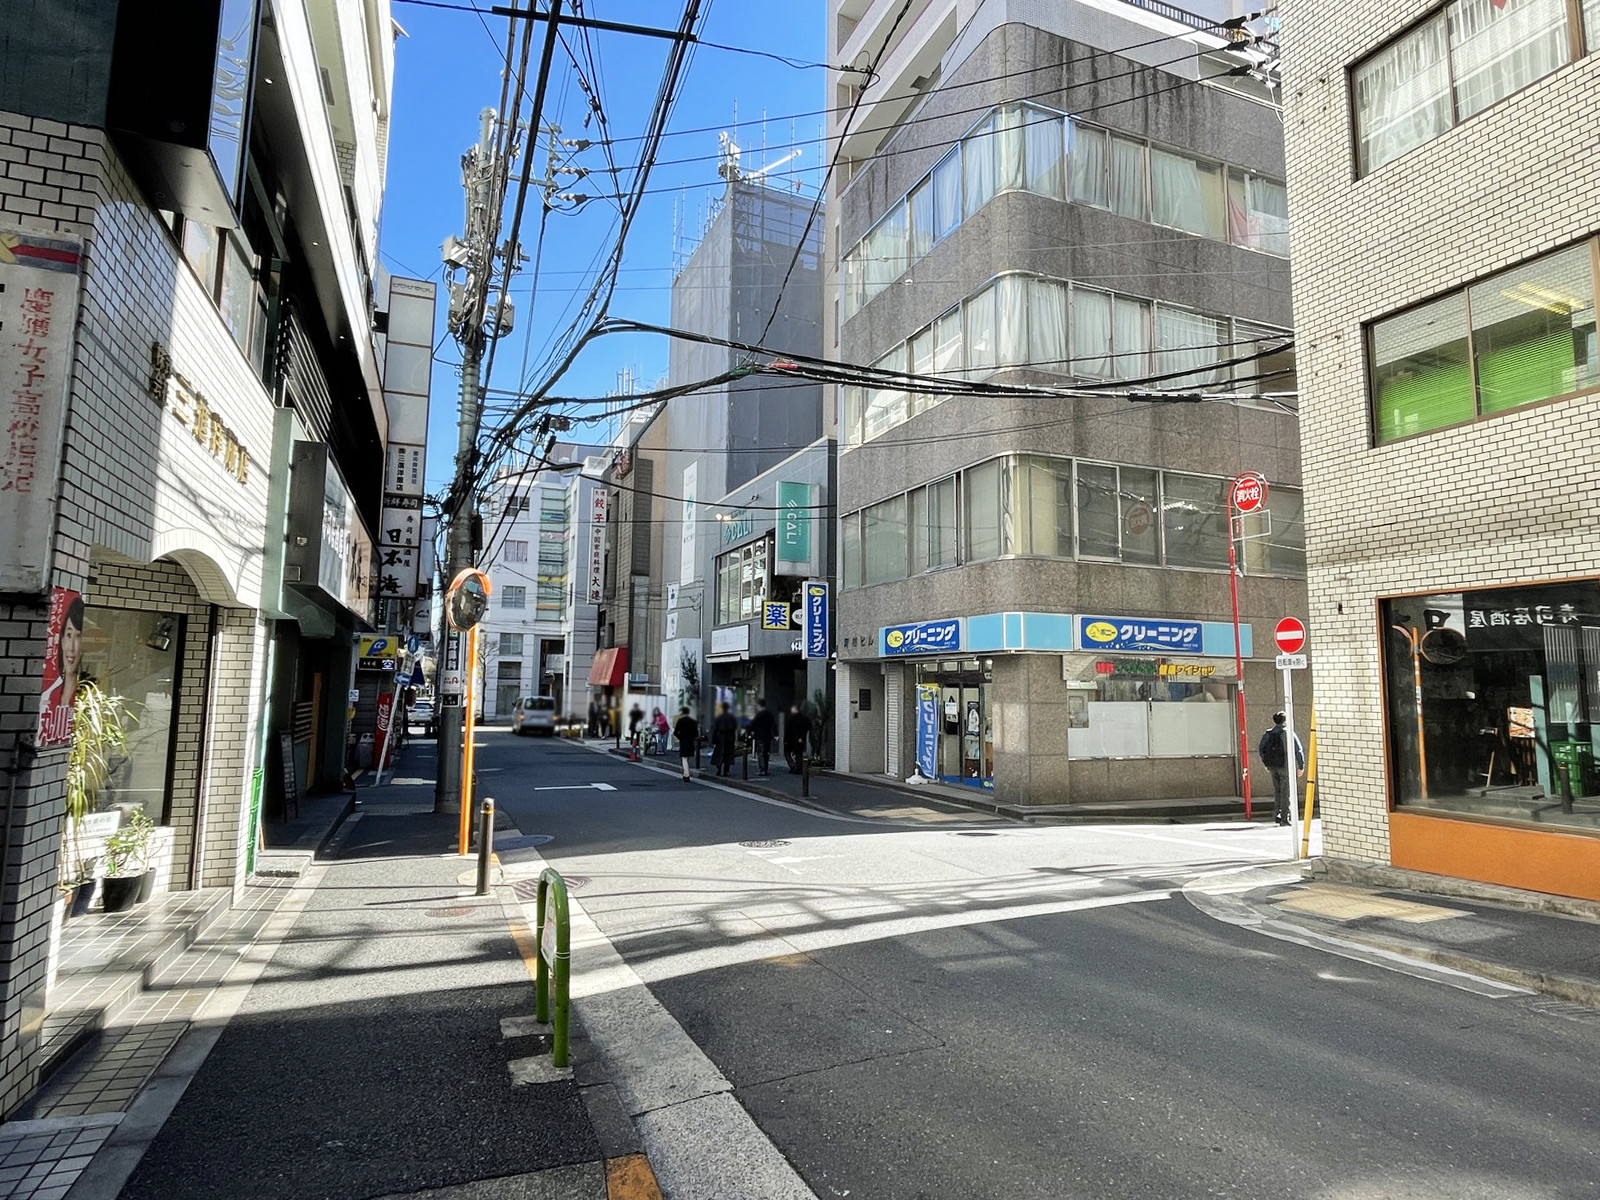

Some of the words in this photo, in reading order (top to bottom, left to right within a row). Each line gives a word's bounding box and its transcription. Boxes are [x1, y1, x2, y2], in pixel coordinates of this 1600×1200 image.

[1236, 487, 1259, 503] 消火栓
[594, 498, 604, 523] 餃子
[380, 528, 403, 594] 日本海
[766, 603, 787, 627] 薬
[812, 596, 825, 652] クリーニング
[904, 624, 956, 645] クリーニング
[1120, 624, 1198, 643] クリーニング
[381, 659, 394, 670] 空
